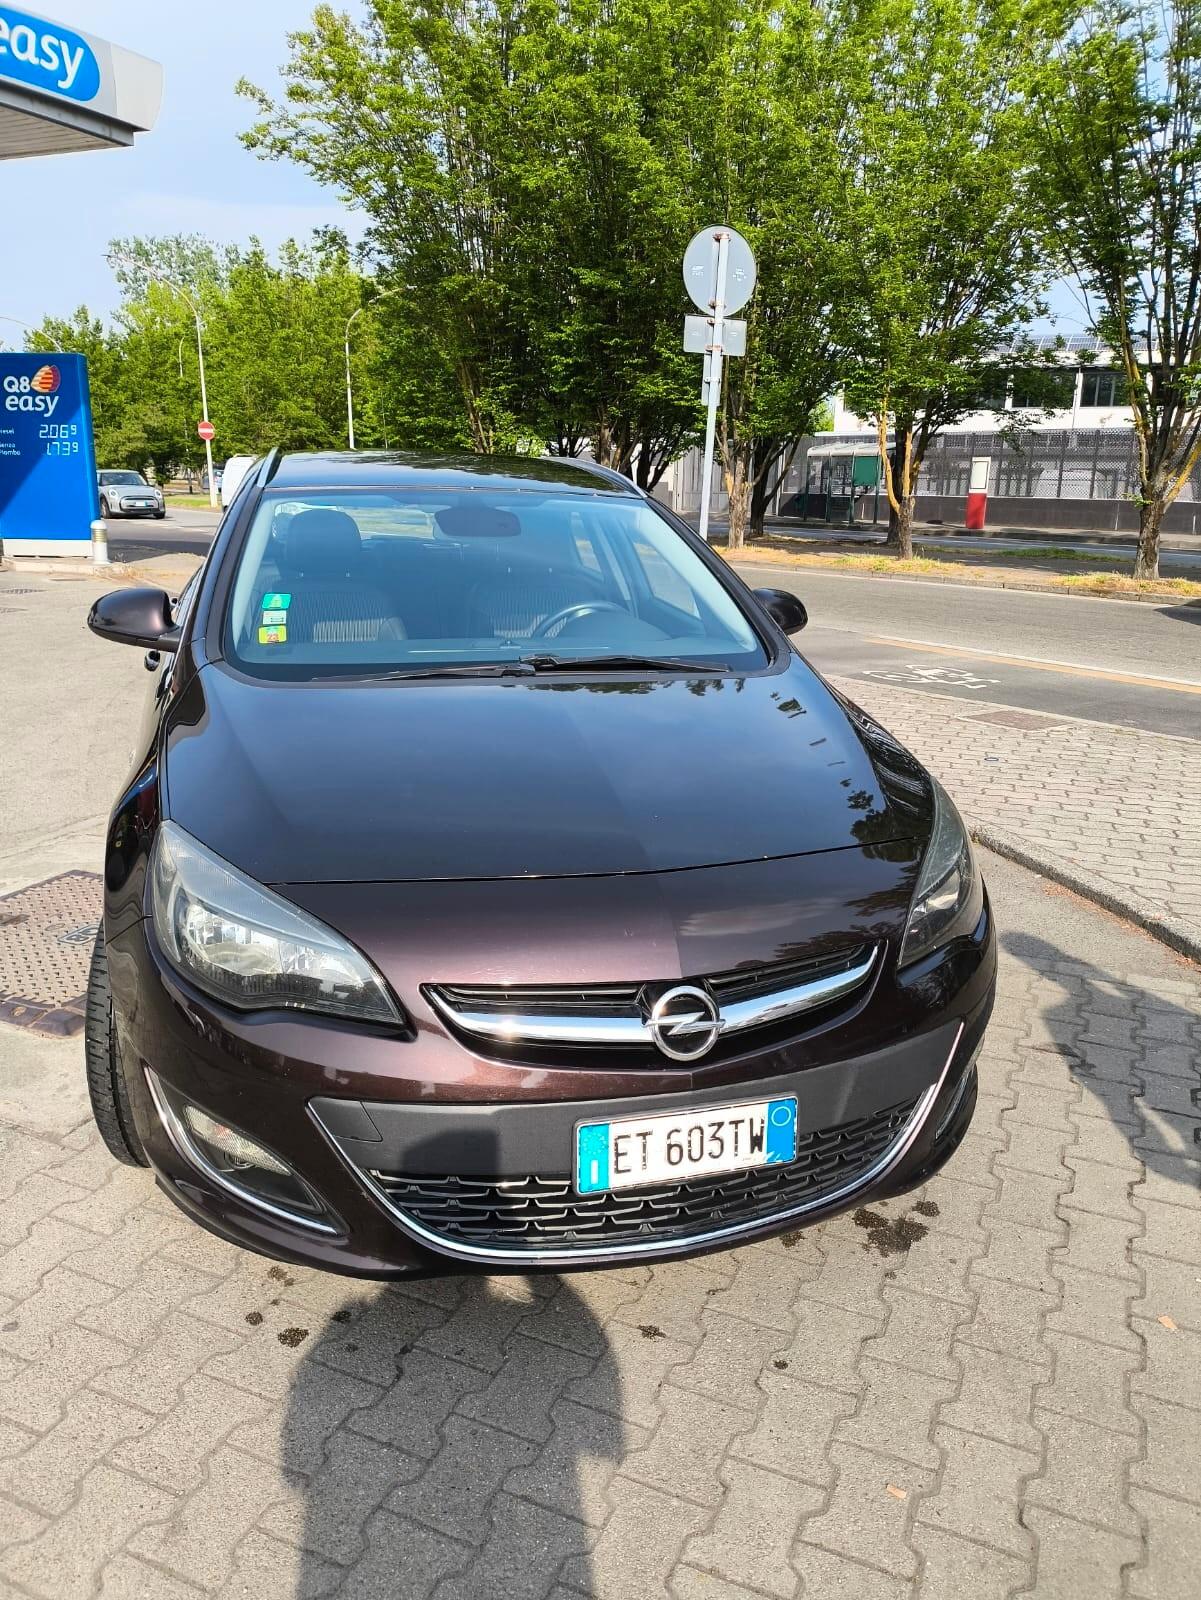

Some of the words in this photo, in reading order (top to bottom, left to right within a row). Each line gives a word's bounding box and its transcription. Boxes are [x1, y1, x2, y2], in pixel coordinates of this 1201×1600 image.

[3, 375, 31, 393] Q8
[5, 395, 59, 417] easy
[613, 1129, 653, 1174] ET
[666, 1116, 765, 1166] 603TW
